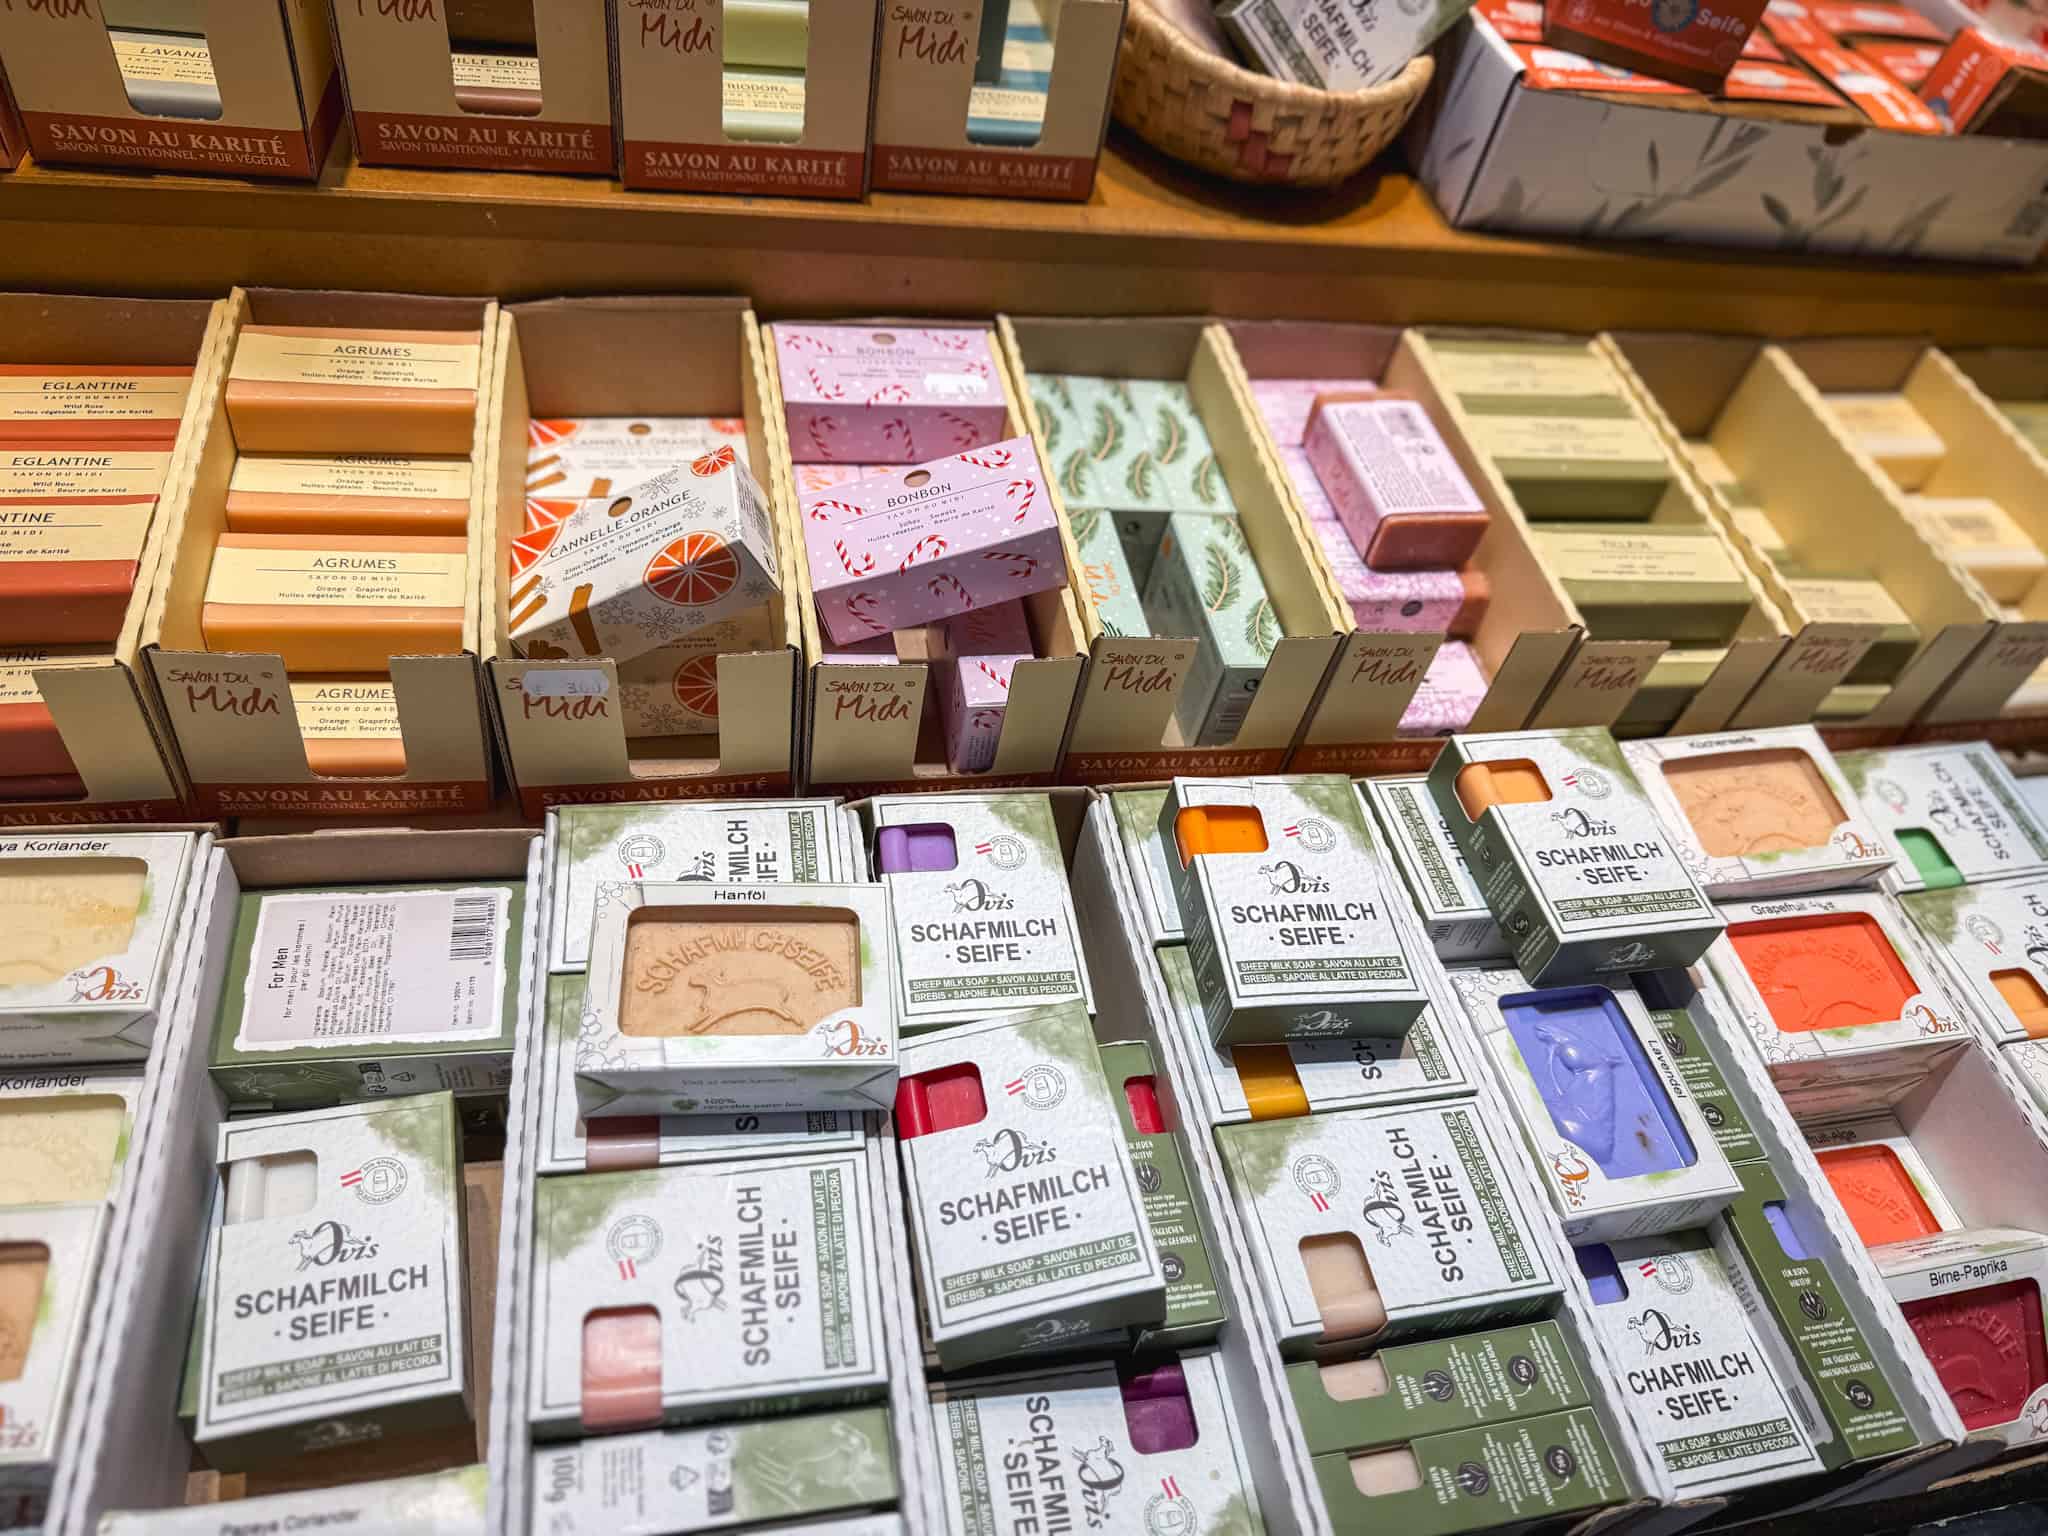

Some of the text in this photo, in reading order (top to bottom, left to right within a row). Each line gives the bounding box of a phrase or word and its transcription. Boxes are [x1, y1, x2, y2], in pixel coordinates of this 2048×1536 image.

[891, 6, 954, 24] SAVON DU
[640, 12, 714, 54] Midi
[898, 25, 969, 65] Midi
[1303, 13, 1339, 65] SEIFE
[49, 123, 286, 156] SAVON AU KARITÉ
[378, 122, 595, 149] SAVON AU KARITÉ
[381, 140, 420, 153] SAVON
[424, 141, 512, 158] TRADITIONNEL
[522, 146, 546, 158] PUR
[56, 142, 99, 153] SAVON
[104, 144, 197, 161] TRADITIONNEL
[209, 152, 233, 162] PUR
[645, 151, 848, 177] SAVON AU KARITÉ
[888, 154, 959, 176] SAVON
[966, 160, 994, 175] AU
[333, 345, 412, 357] AGRUMES
[42, 381, 140, 391] EGLANTINE
[12, 457, 113, 466] EGLANTINE
[886, 482, 952, 508] BONBON
[549, 489, 691, 559] CANNELLE-ORANGE
[313, 557, 398, 569] AGRUMES
[167, 670, 252, 684] SAVON DU
[1103, 665, 1177, 694] Midi
[1352, 659, 1423, 685] Midi
[186, 685, 281, 716] Midi
[834, 694, 913, 722] Midi
[1079, 752, 1265, 769] SAVON AU KARITÉ
[217, 786, 465, 802] SAVON AU KARITÉ
[542, 776, 769, 805] SAVON AU KARITÉ
[1564, 807, 1617, 837] Ovis
[23, 840, 110, 851] Koriander
[1535, 842, 1664, 867] SCHAFMILCH
[1274, 860, 1330, 894] Ovis
[1583, 865, 1644, 885] SEIFE
[714, 889, 766, 901] Hanföl
[959, 878, 1015, 912] Ovis
[1231, 902, 1378, 924] SCHAFMILCH
[910, 917, 1057, 943] SCHAFMILCH
[1279, 926, 1346, 947] SEIFE
[268, 947, 290, 990] For Men
[956, 942, 1022, 964] SEIFE
[1240, 958, 1400, 972] SHEEP MILK SOAP SAVON AU LAIT DE
[83, 966, 145, 1001] Ovis
[912, 972, 1073, 990] SHEEP MILK SOAP SAVON AU LAIT DE
[1243, 970, 1404, 983] BREBIS SAPONE AL LATTE DI PECORA
[1914, 1004, 1960, 1035] Ovis
[834, 1020, 888, 1057] Ovis
[0, 1073, 88, 1090] Koriander
[1648, 1039, 1687, 1100] Lavendel
[992, 1127, 1057, 1172] Ovis
[938, 1163, 1111, 1226] SCHAFMILCH
[1362, 1169, 1405, 1229] Ovis
[1385, 1127, 1465, 1283] SCHAFMILCH
[1428, 1164, 1474, 1232] SEIFE
[1444, 1112, 1520, 1279] SHEEP MILK SOAP SAVON AU LAIT DE
[1457, 1112, 1533, 1277] BREBIS SAPONE AL LATTE DI PECORA
[993, 1204, 1072, 1245] SEIFE
[312, 1220, 379, 1267] Ovis
[674, 1234, 724, 1300] Ovis
[736, 1186, 771, 1367] SCHAFMILCH
[771, 1230, 801, 1310] SEIFE
[945, 1236, 1133, 1290] SHEEP MILK SOAP SAVON AU LAIT DE
[948, 1250, 1137, 1307] BREBIS SAPONE AL LATTE DI PECORA
[1929, 1259, 2008, 1288] Birne-Paprika
[233, 1263, 430, 1321] SCHAFMILCH
[289, 1304, 376, 1342] SEIFE
[1642, 1309, 1702, 1352] Ovis
[1627, 1352, 1755, 1395] CHAFMILCH
[1665, 1387, 1733, 1421] SEIFE
[1666, 1420, 1790, 1454] MILK SOAP SAVON AU LAIT DE
[1681, 1435, 1796, 1469] SAPONE AL LATTE DI PECORA
[1002, 1451, 1039, 1536] SEIFE
[1078, 1458, 1124, 1529] Ovis
